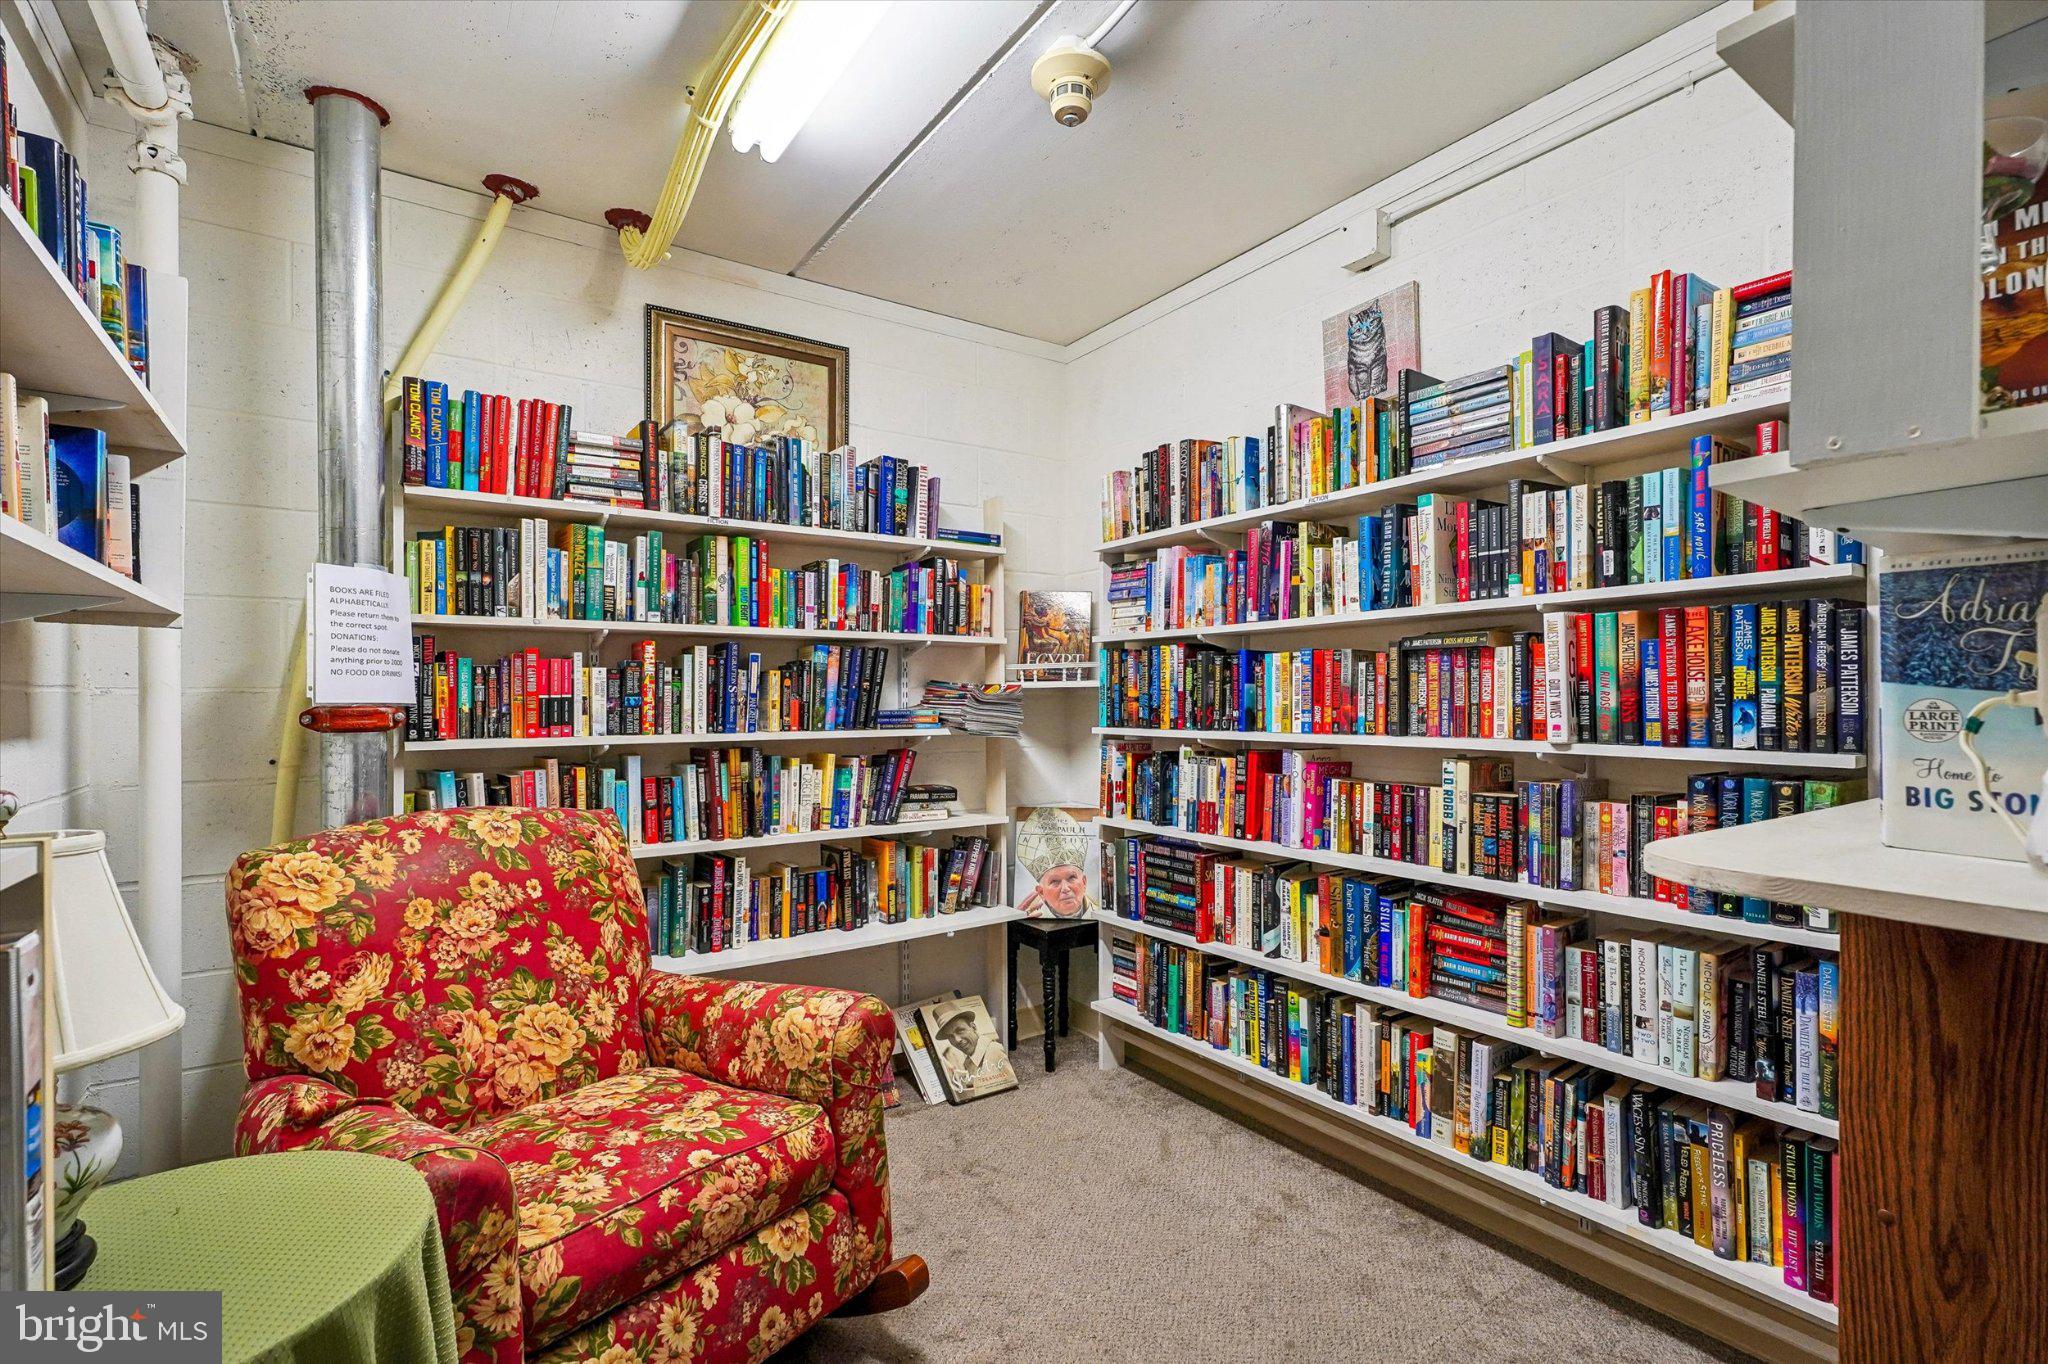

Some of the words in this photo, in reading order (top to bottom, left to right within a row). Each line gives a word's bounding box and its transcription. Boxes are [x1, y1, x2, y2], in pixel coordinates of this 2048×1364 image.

[1601, 311, 1609, 336] ROBERT
[410, 383, 419, 401] TOM
[430, 387, 440, 405] TOM
[411, 403, 420, 439] CLANCY
[431, 407, 441, 442] CLANCY
[699, 436, 707, 456] ROBIN
[698, 479, 708, 503] CRISIS
[1384, 521, 1392, 541] LONG
[1694, 512, 1706, 533] SARA
[574, 544, 585, 575] MAZE
[1384, 543, 1392, 567] BRIGHT
[330, 586, 357, 594] BOOKS
[1383, 570, 1391, 592] RIVER
[1895, 573, 2036, 624] Adria
[1548, 620, 1559, 639] JAMES
[1665, 614, 1676, 636] JAMES
[1714, 611, 1724, 635] James
[1761, 607, 1776, 634] JAMES
[1787, 608, 1799, 632] JAMES
[1817, 604, 1826, 638] AMERICAN
[1735, 610, 1744, 660] PATTERSON
[1744, 620, 1752, 649] JAMES
[1840, 629, 1858, 660] JAMES
[330, 657, 364, 665] anything
[1548, 640, 1559, 672] PATTERSON
[1666, 639, 1677, 676] PATTERSON
[1714, 637, 1724, 674] Patterson
[1761, 636, 1776, 681] PATTERSON
[1785, 634, 1803, 695] PATTERSON
[1816, 641, 1827, 668] HEROES
[1549, 679, 1560, 697] GUILTY
[1580, 680, 1589, 693] THE
[1600, 671, 1609, 688] RUN
[1645, 668, 1658, 686] JAMES
[1667, 680, 1677, 694] THE
[1715, 677, 1725, 691] The
[1734, 666, 1746, 699] ROGUE
[1747, 670, 1755, 694] PRIVATE
[1816, 670, 1826, 692] JAMES
[1600, 691, 1610, 709] ROSE
[1841, 664, 1859, 715] PATTERSON
[1550, 701, 1561, 718] WIVES
[1580, 696, 1589, 724] RUSSIAN
[1646, 688, 1659, 718] PATTERSON
[1668, 697, 1677, 709] RED
[1761, 688, 1776, 728] PARANOIA
[1668, 712, 1678, 729] BOOK
[1713, 704, 1725, 732] Lawyer
[1785, 697, 1801, 737] Writer
[1817, 696, 1826, 735] PATTERSON
[1910, 712, 1959, 721] LARGE
[1910, 722, 1959, 730] PRINT
[1913, 758, 1975, 781] Home
[1443, 789, 1454, 818] ROBB
[1693, 794, 1708, 813] NORA
[1723, 791, 1738, 810] NORA
[1906, 786, 1954, 809] BIG
[1346, 884, 1355, 910] Daniel
[1363, 888, 1372, 912] Daniel
[1346, 913, 1356, 932] Silva
[1363, 914, 1372, 933] Silva
[1380, 907, 1391, 933] SILVA
[1363, 946, 1373, 968] Heist
[1638, 948, 1646, 985] NICHOLAS
[1257, 974, 1265, 996] BRAD
[1703, 961, 1712, 1006] NICHOLAS
[1757, 954, 1767, 993] DANIELLE
[1638, 987, 1646, 1011] SPARKS
[1781, 978, 1794, 1014] DANIELLE
[1822, 967, 1832, 1008] DANIELLE
[1258, 997, 1266, 1018] THOR
[1757, 995, 1767, 1019] STEEL
[1702, 1010, 1711, 1039] SPARKS
[1782, 1017, 1794, 1040] STEEL
[1799, 1016, 1812, 1046] DANIELLE
[1822, 1010, 1832, 1032] STEEL
[1784, 1042, 1792, 1062] Honor
[1799, 1049, 1811, 1068] STEEL
[1783, 1064, 1794, 1086] Thyself
[1801, 1072, 1810, 1092] BLUE
[1823, 1064, 1833, 1097] Palazzo
[1632, 1094, 1644, 1127] WAGES
[1635, 1137, 1646, 1153] SIN
[1662, 1122, 1670, 1145] SUSAN
[1711, 1122, 1725, 1188] PRICELESS
[1786, 1144, 1796, 1179] STUART
[1813, 1154, 1824, 1190] STUART
[1787, 1182, 1797, 1217] WOODS
[1813, 1192, 1824, 1229] WOODS
[1787, 1229, 1798, 1245] HIT
[1788, 1249, 1798, 1271] LIST
[1815, 1240, 1824, 1279] STEALTH
